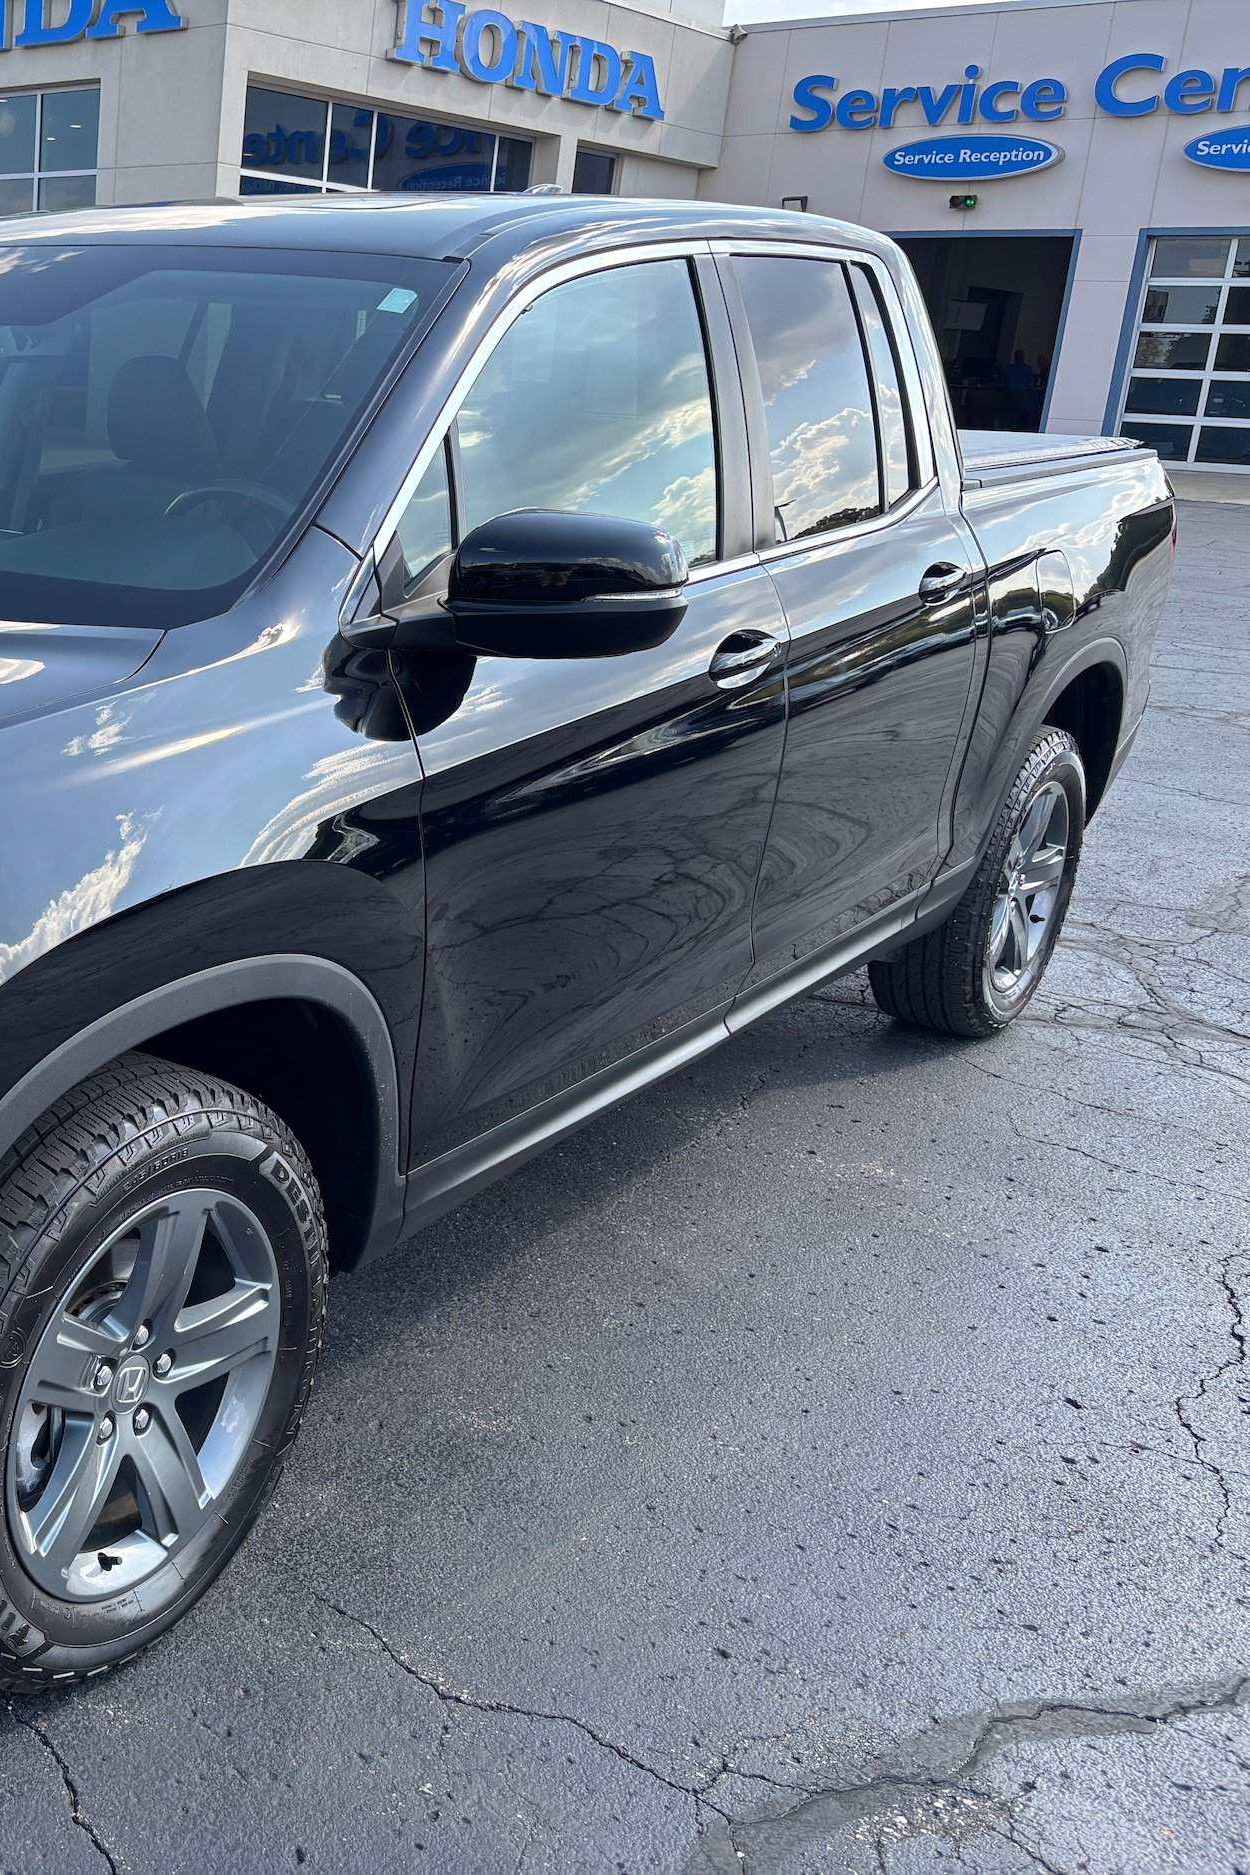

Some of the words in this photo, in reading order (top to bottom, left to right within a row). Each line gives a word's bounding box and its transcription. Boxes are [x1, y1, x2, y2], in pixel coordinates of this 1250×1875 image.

[393, 0, 665, 121] HONDA
[789, 64, 1067, 132] Service
[893, 150, 955, 165] Service
[958, 147, 1045, 165] Reception
[1196, 139, 1250, 156] Servi
